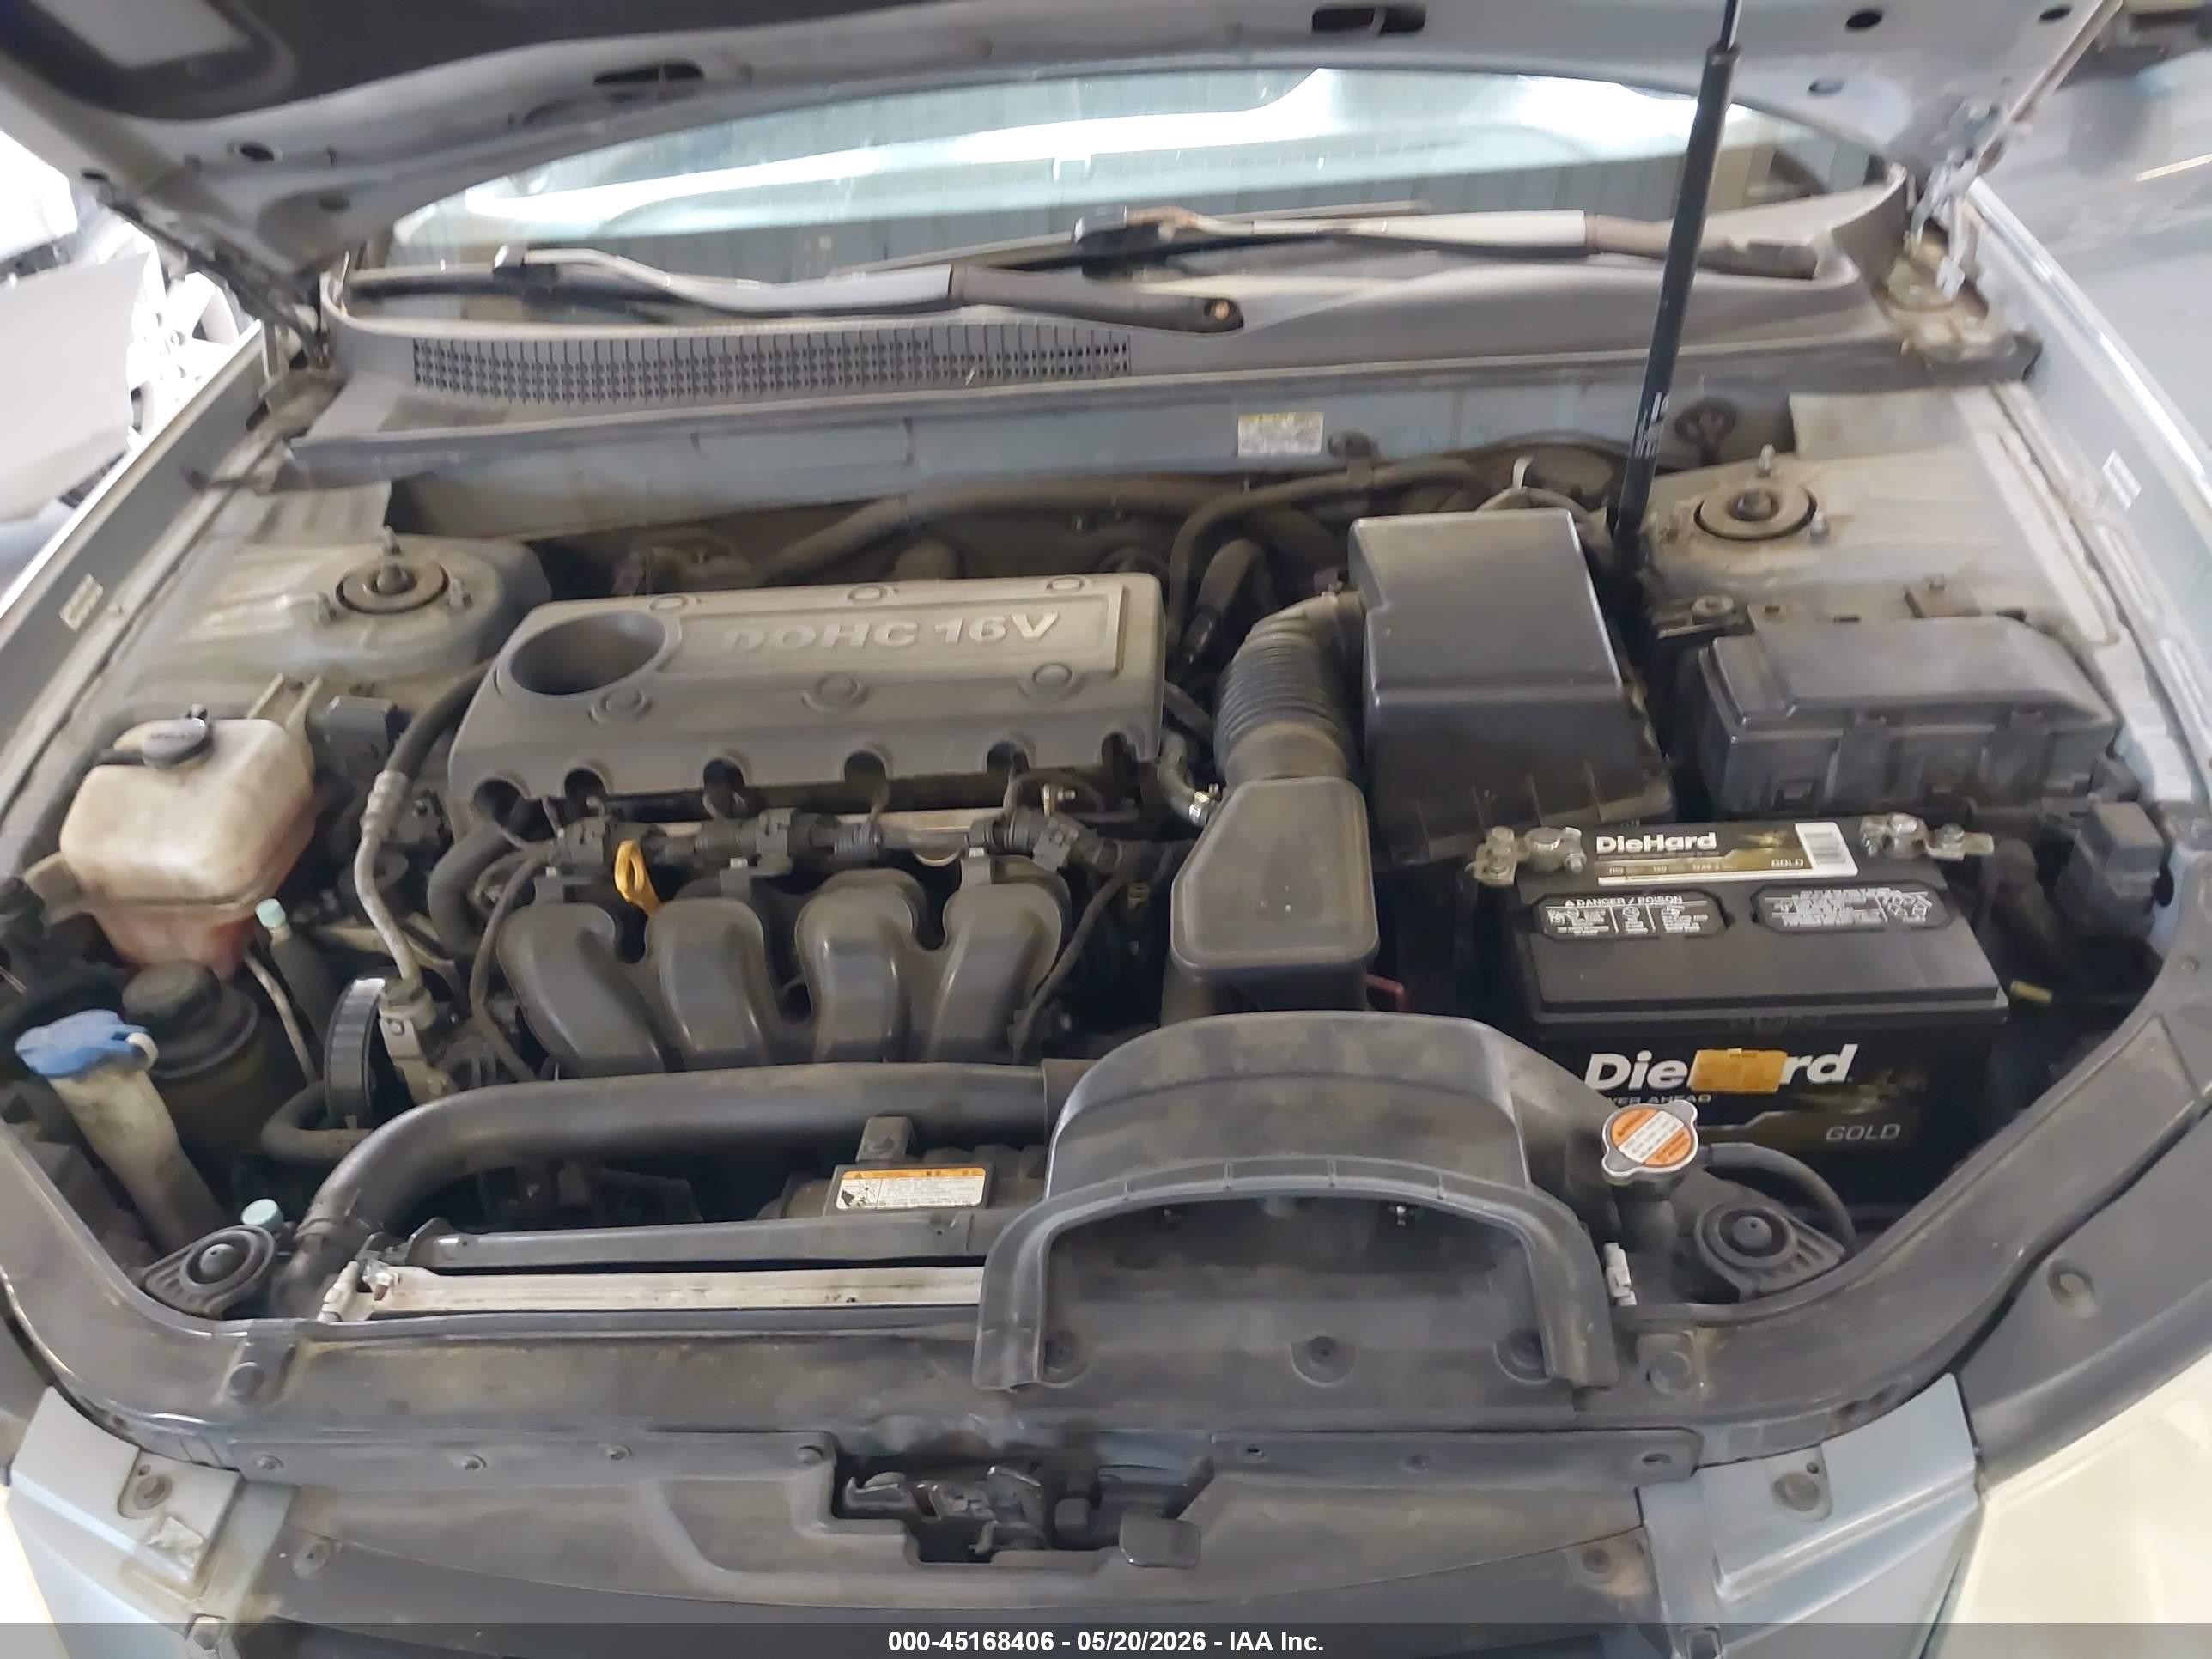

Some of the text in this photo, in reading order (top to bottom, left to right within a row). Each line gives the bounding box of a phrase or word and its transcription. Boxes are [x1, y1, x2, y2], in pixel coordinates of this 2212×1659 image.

[720, 611, 1060, 653] DOHC 16V
[1595, 831, 1717, 855] DieHard
[1577, 896, 1626, 907] DANGER
[1638, 895, 1683, 906] POISON
[1584, 1043, 1858, 1091] Dierd
[1826, 1123, 1901, 1142] GOLD
